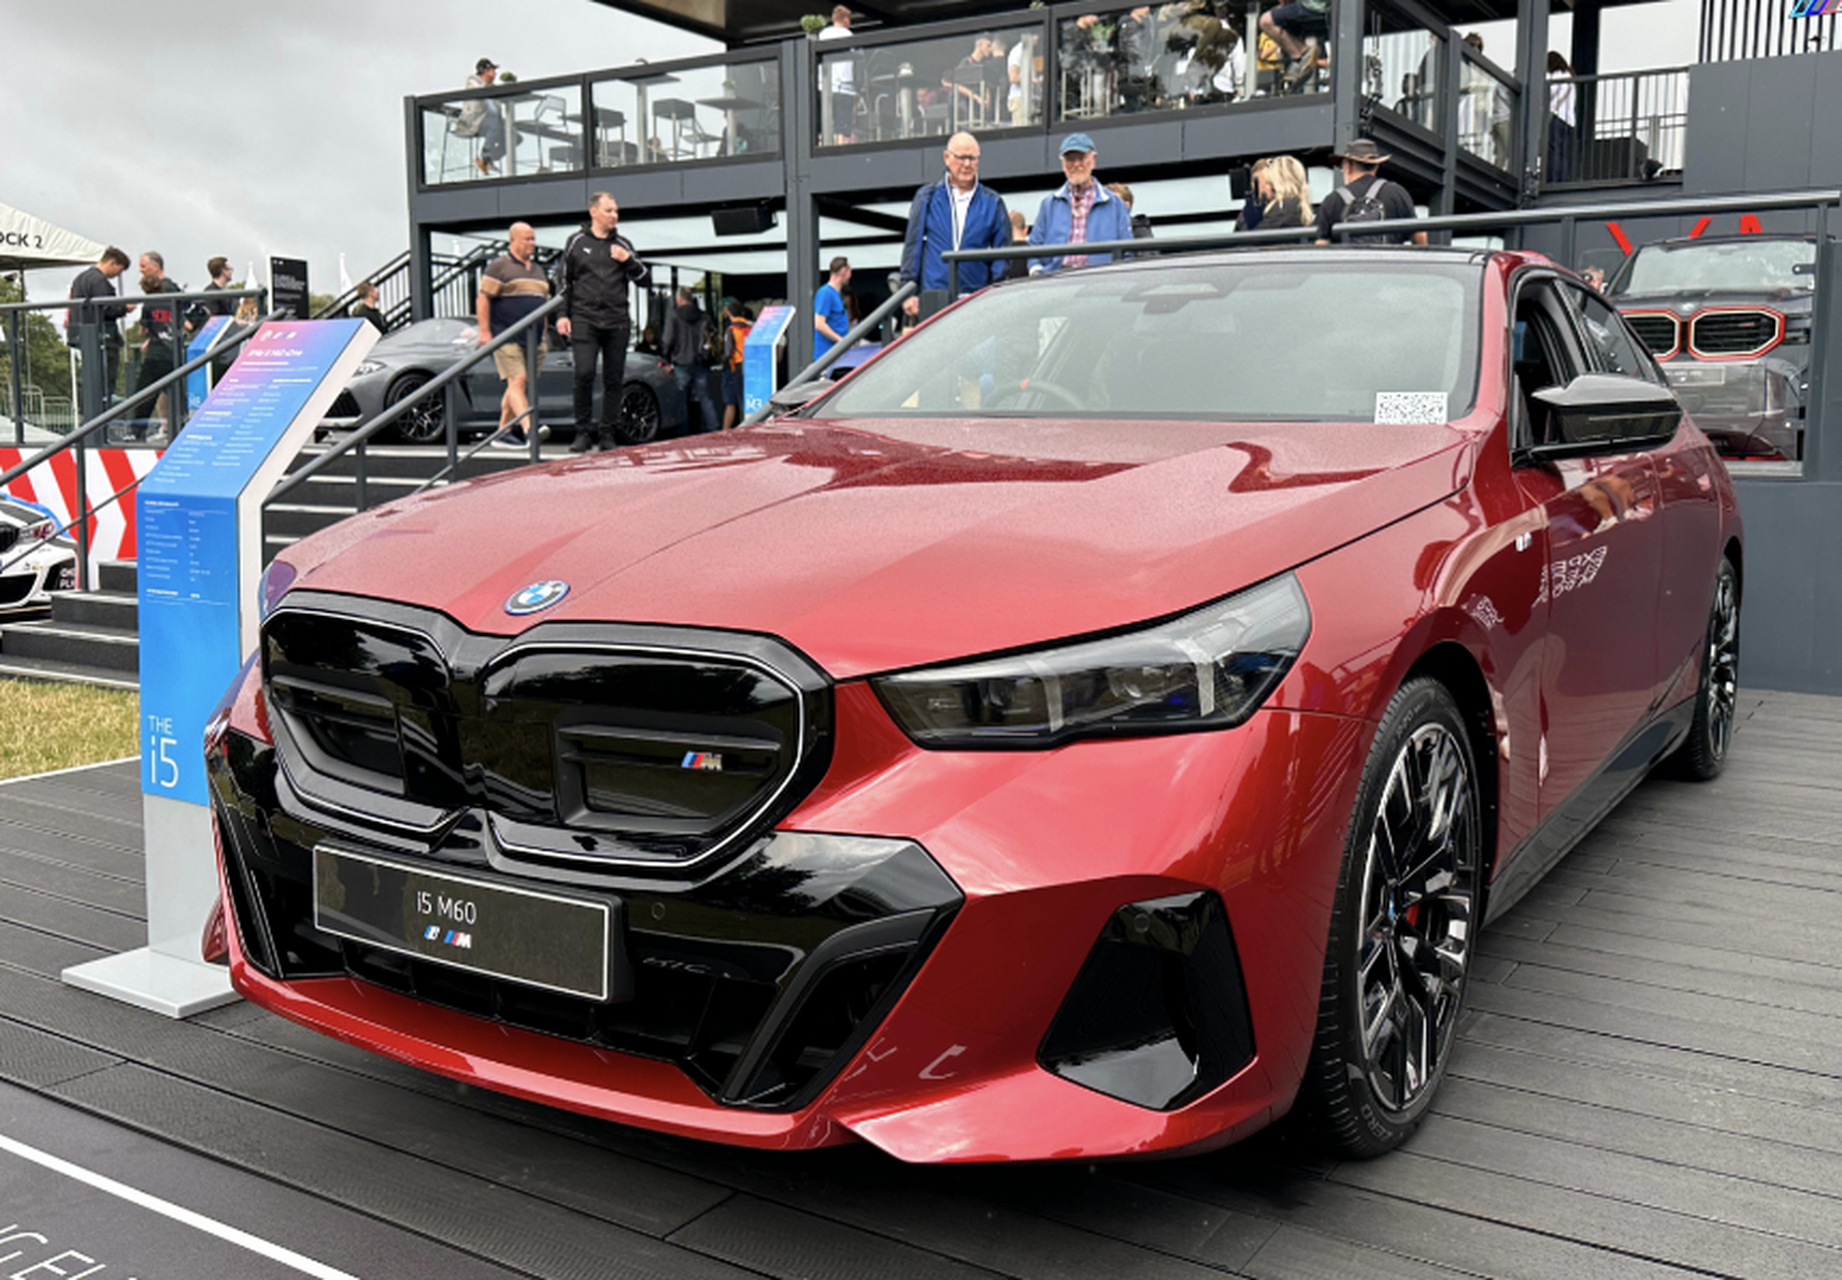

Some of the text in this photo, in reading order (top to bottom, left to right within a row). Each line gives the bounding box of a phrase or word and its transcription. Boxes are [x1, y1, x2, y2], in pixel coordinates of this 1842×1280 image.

[34, 234, 43, 249] 2
[148, 715, 172, 735] THE
[151, 735, 179, 788] i5
[437, 896, 476, 925] M60
